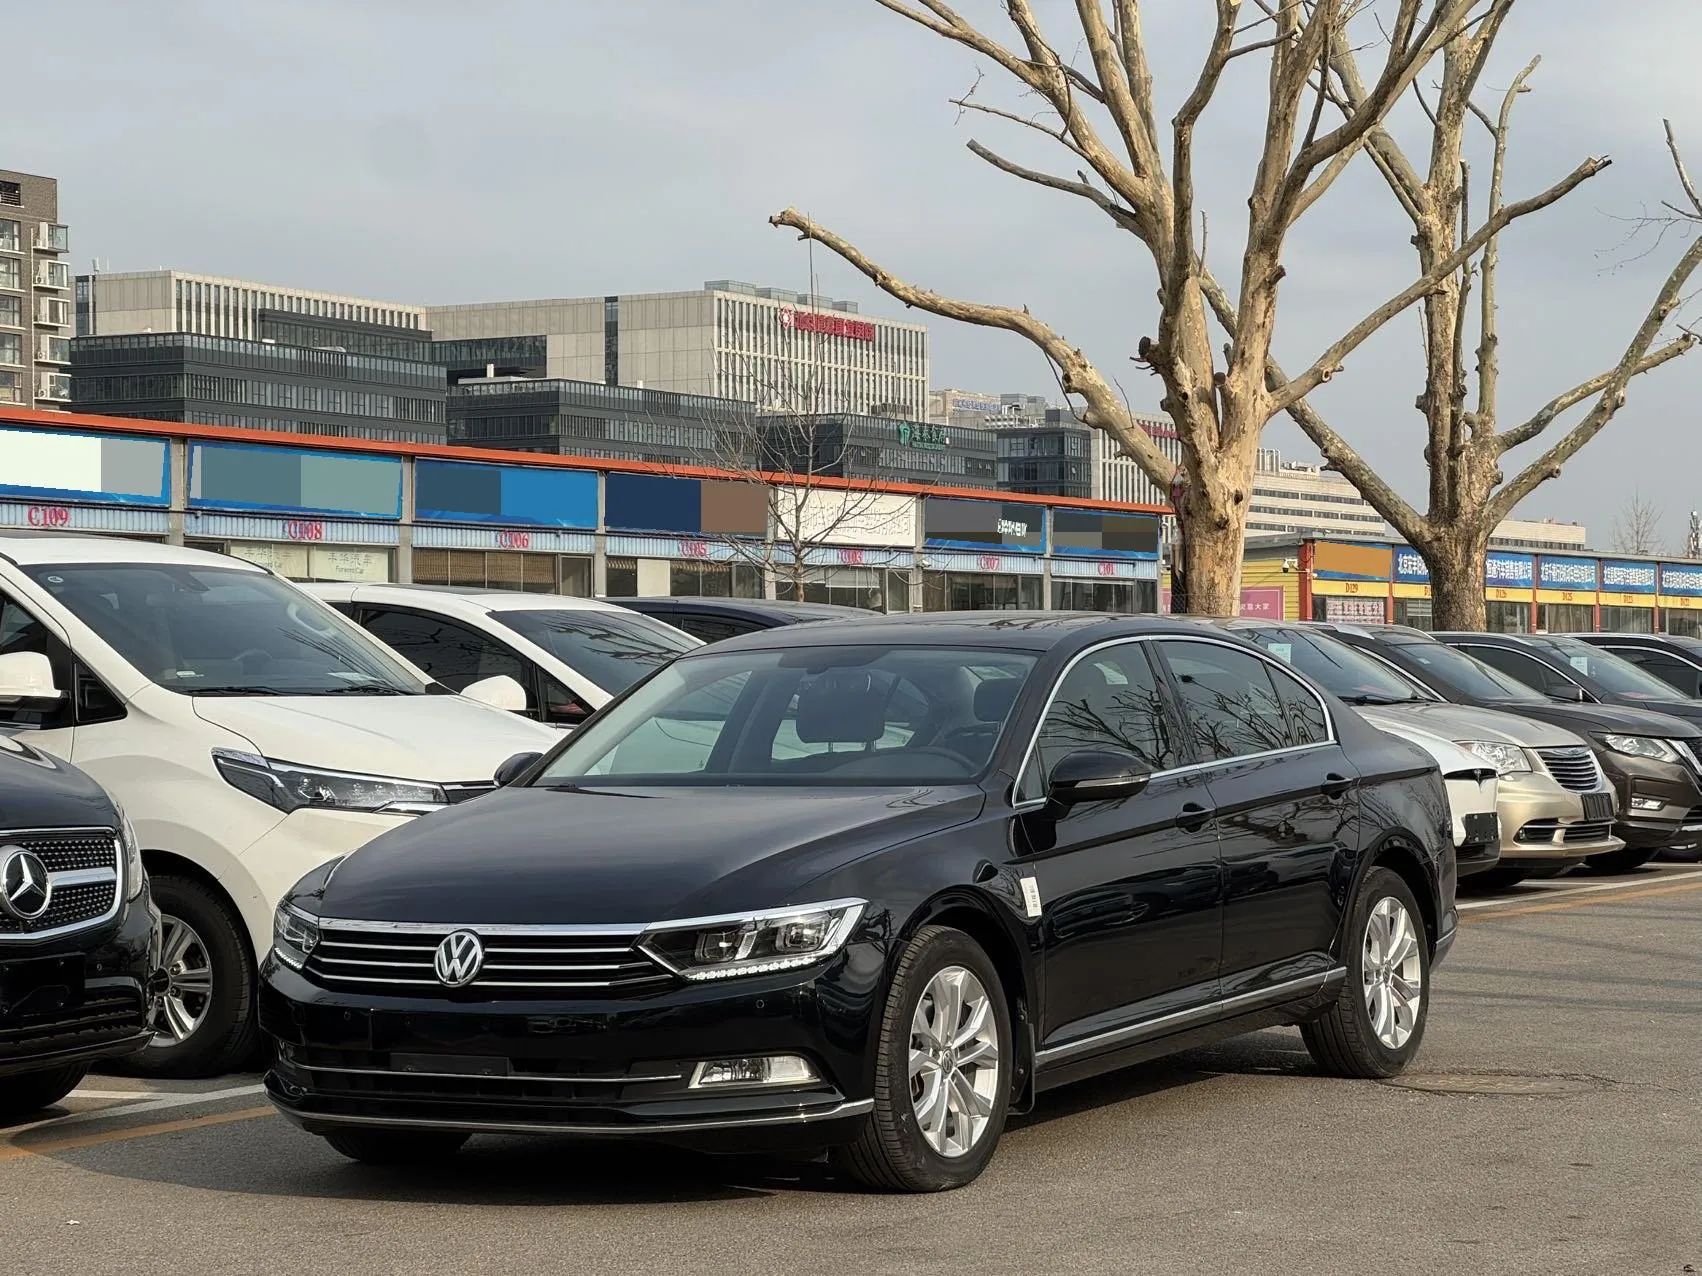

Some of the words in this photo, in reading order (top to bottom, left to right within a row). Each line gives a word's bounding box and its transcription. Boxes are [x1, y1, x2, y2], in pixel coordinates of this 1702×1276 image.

[28, 506, 69, 526] C109
[287, 519, 322, 540] C108
[500, 531, 528, 549] C106
[1345, 582, 1359, 593] D129
